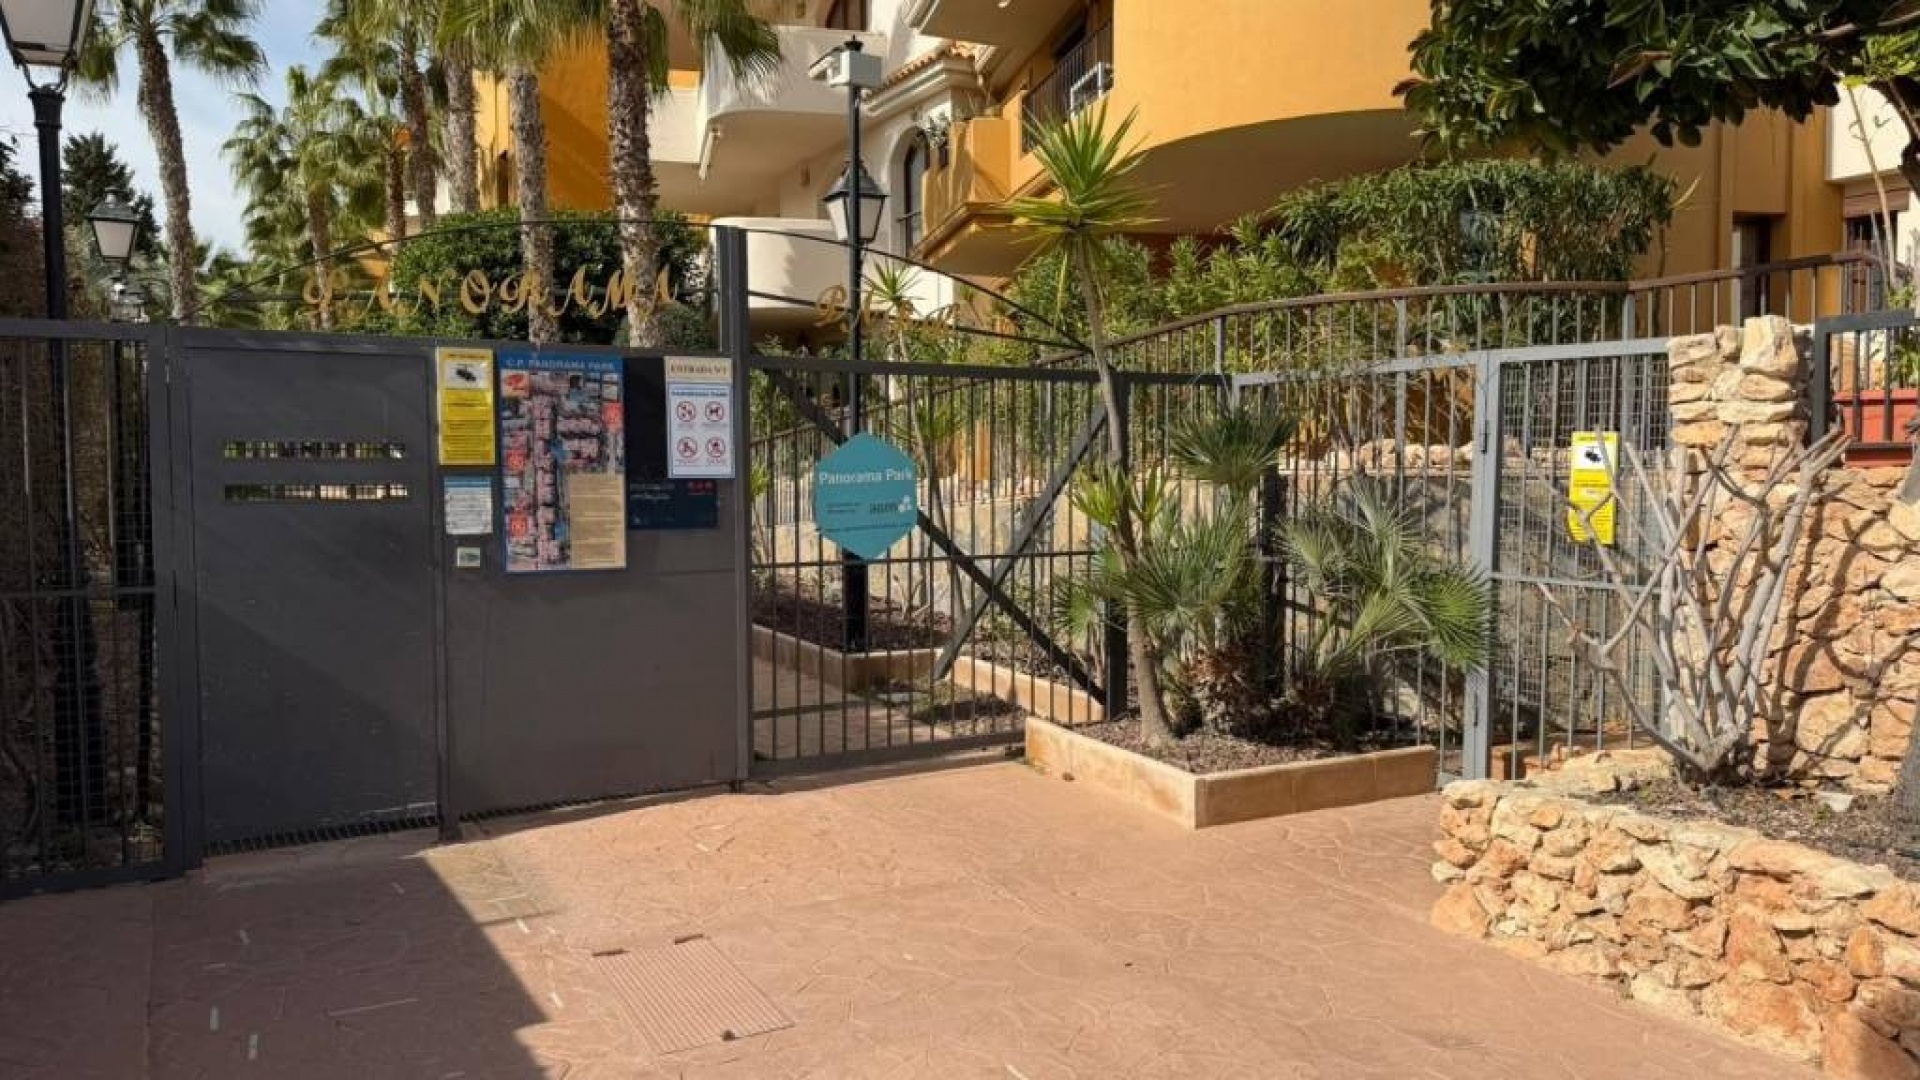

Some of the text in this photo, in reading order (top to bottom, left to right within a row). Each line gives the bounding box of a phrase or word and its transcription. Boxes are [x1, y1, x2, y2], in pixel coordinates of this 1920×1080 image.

[303, 264, 677, 318] PANORAMA
[819, 467, 912, 485] Panorama Park
